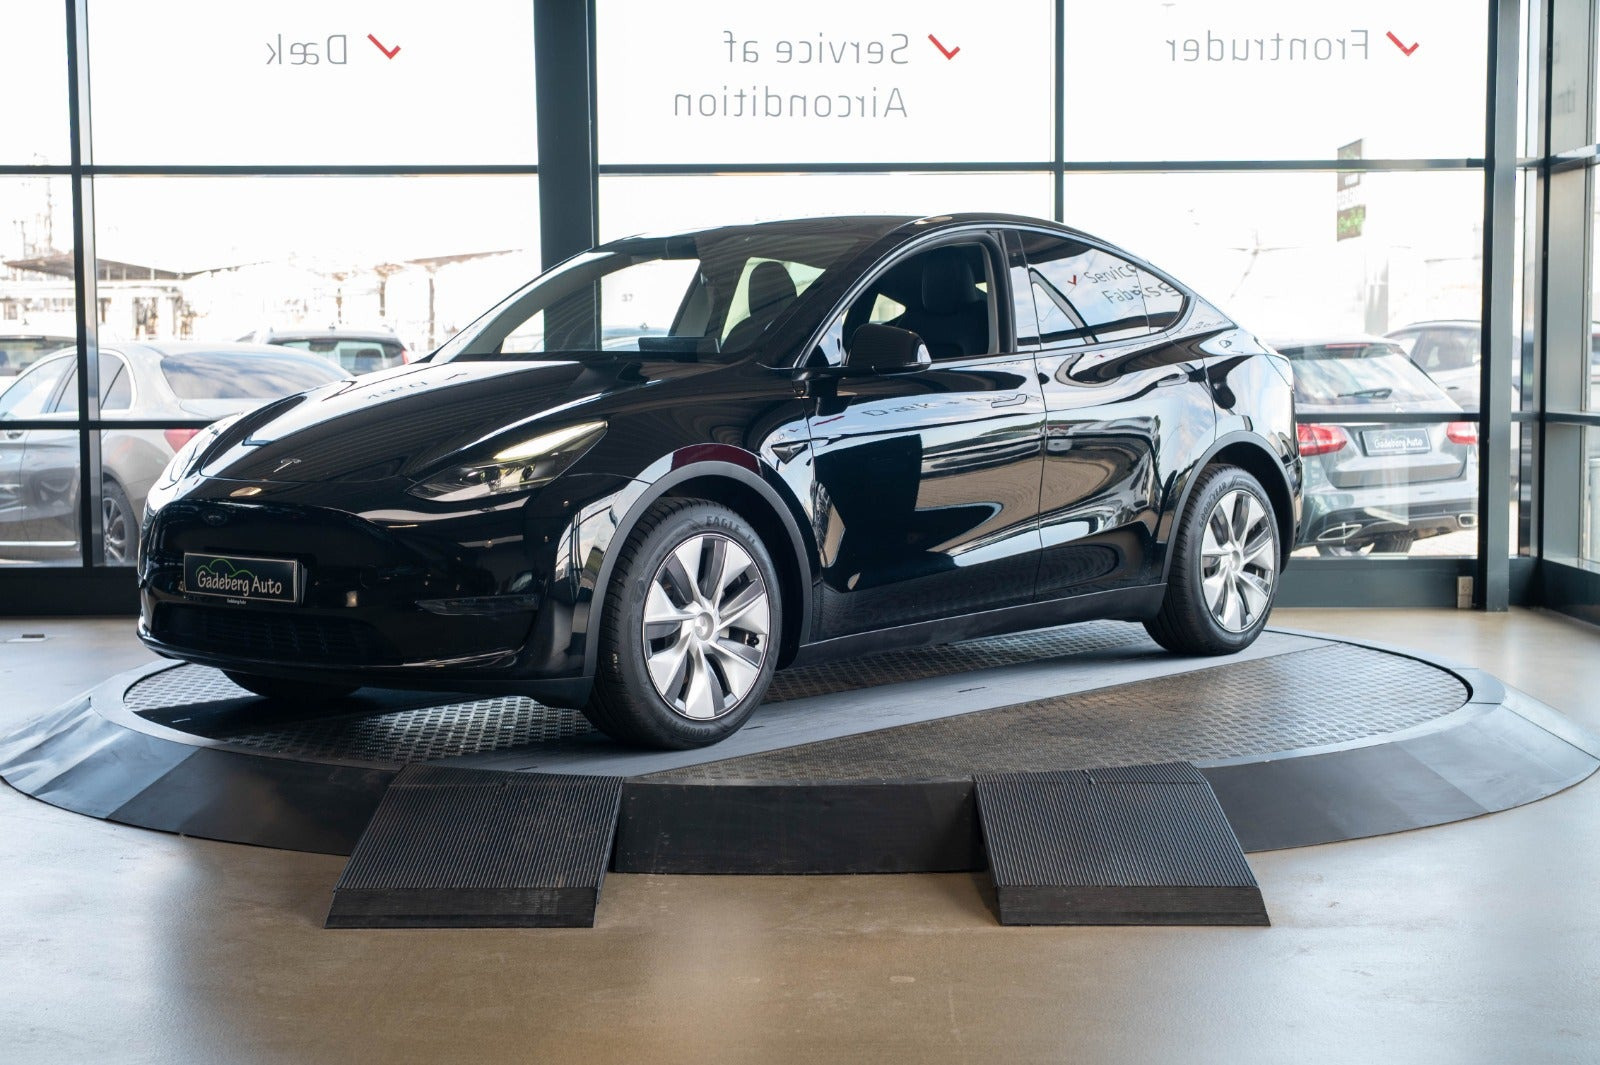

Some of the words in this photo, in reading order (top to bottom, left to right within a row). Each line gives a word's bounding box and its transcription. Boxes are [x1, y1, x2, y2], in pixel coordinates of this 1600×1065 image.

[706, 515, 741, 533] EAGLE
[197, 570, 249, 597] Gadeberg
[251, 575, 282, 595] Auto
